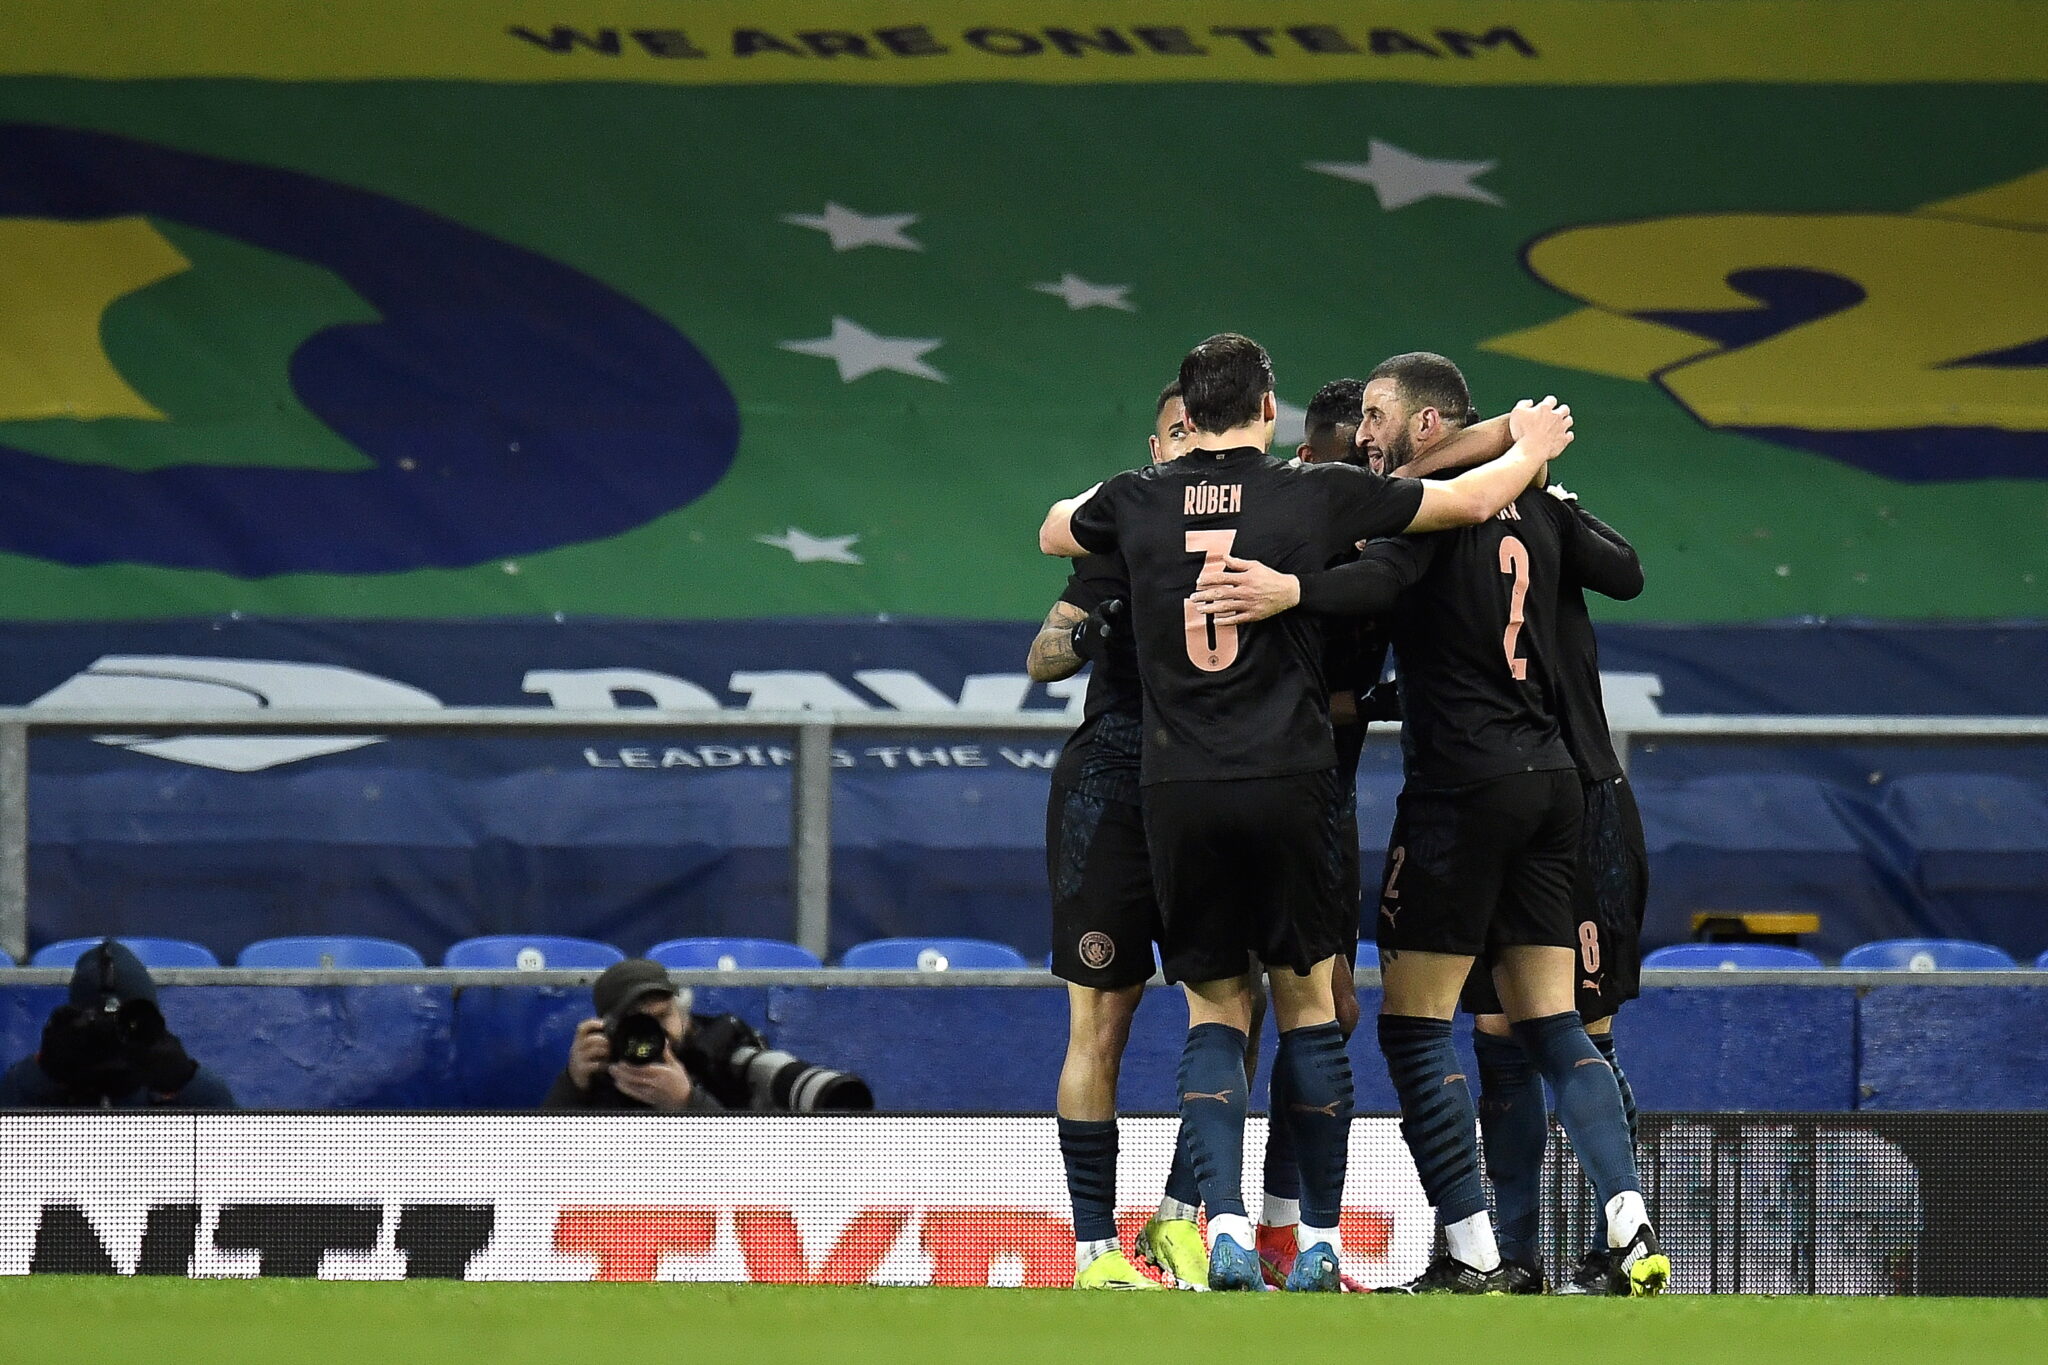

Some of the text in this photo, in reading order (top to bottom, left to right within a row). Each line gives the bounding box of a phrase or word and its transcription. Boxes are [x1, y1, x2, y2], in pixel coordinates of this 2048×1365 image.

[508, 25, 1540, 60] WE ARE ONE TEAM
[1183, 481, 1242, 515] RÚBEN
[1499, 535, 1530, 680] 2
[864, 746, 990, 767] THE
[1384, 846, 1405, 899] 2
[1578, 920, 1600, 974] 8
